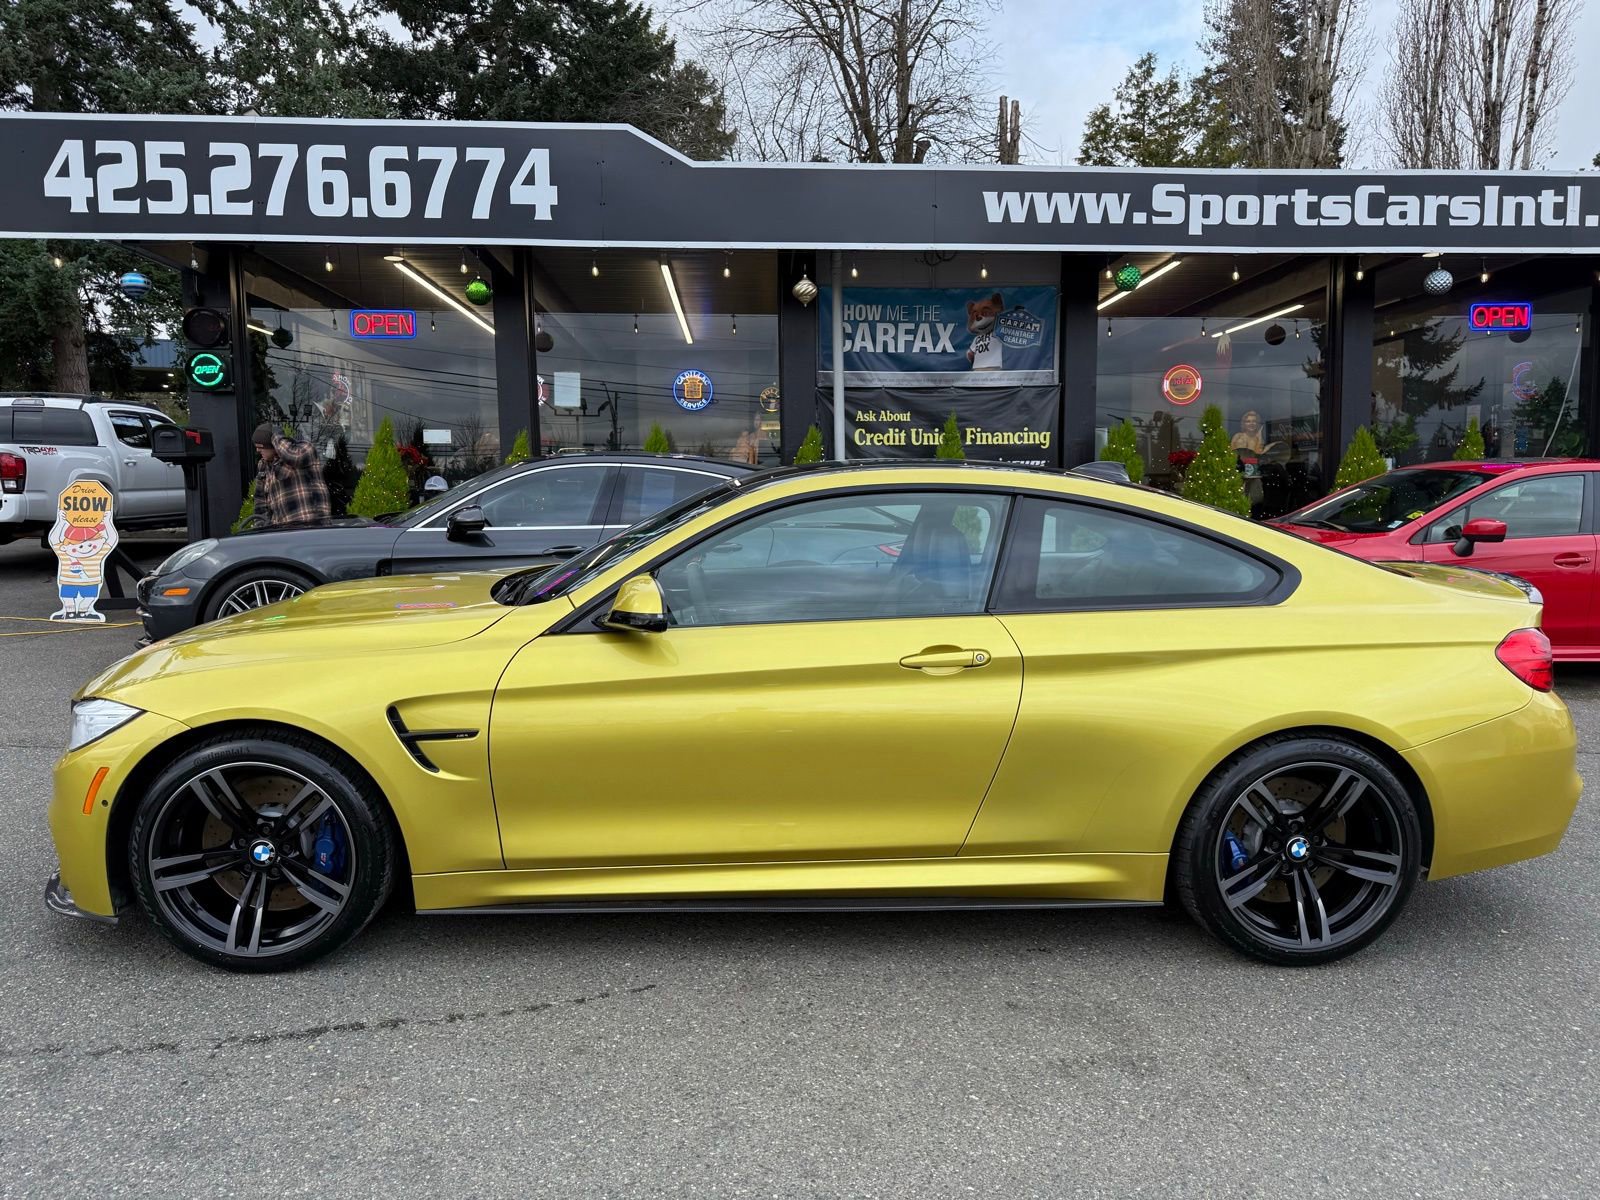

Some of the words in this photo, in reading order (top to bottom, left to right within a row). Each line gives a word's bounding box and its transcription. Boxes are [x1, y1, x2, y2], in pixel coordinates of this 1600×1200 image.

[43, 139, 559, 221] 425.276.6774
[982, 183, 1599, 236] www.SportsCarsIntl.
[842, 304, 882, 321] HOW
[886, 304, 911, 321] ME
[913, 304, 941, 321] THE
[1472, 306, 1529, 327] OPEN
[353, 313, 414, 335] OPEN
[1000, 326, 1036, 340] ADVANTAGE
[1003, 334, 1028, 345] DEALER
[194, 365, 220, 375] OPEN
[676, 370, 711, 386] CADILLAC
[680, 398, 708, 410] SERVICE
[855, 410, 877, 422] Ask
[878, 410, 911, 422] About
[854, 428, 907, 446] Credit
[965, 427, 1051, 449] Financing
[72, 485, 97, 494] Drive
[63, 496, 108, 512] SLOW
[72, 515, 98, 523] please
